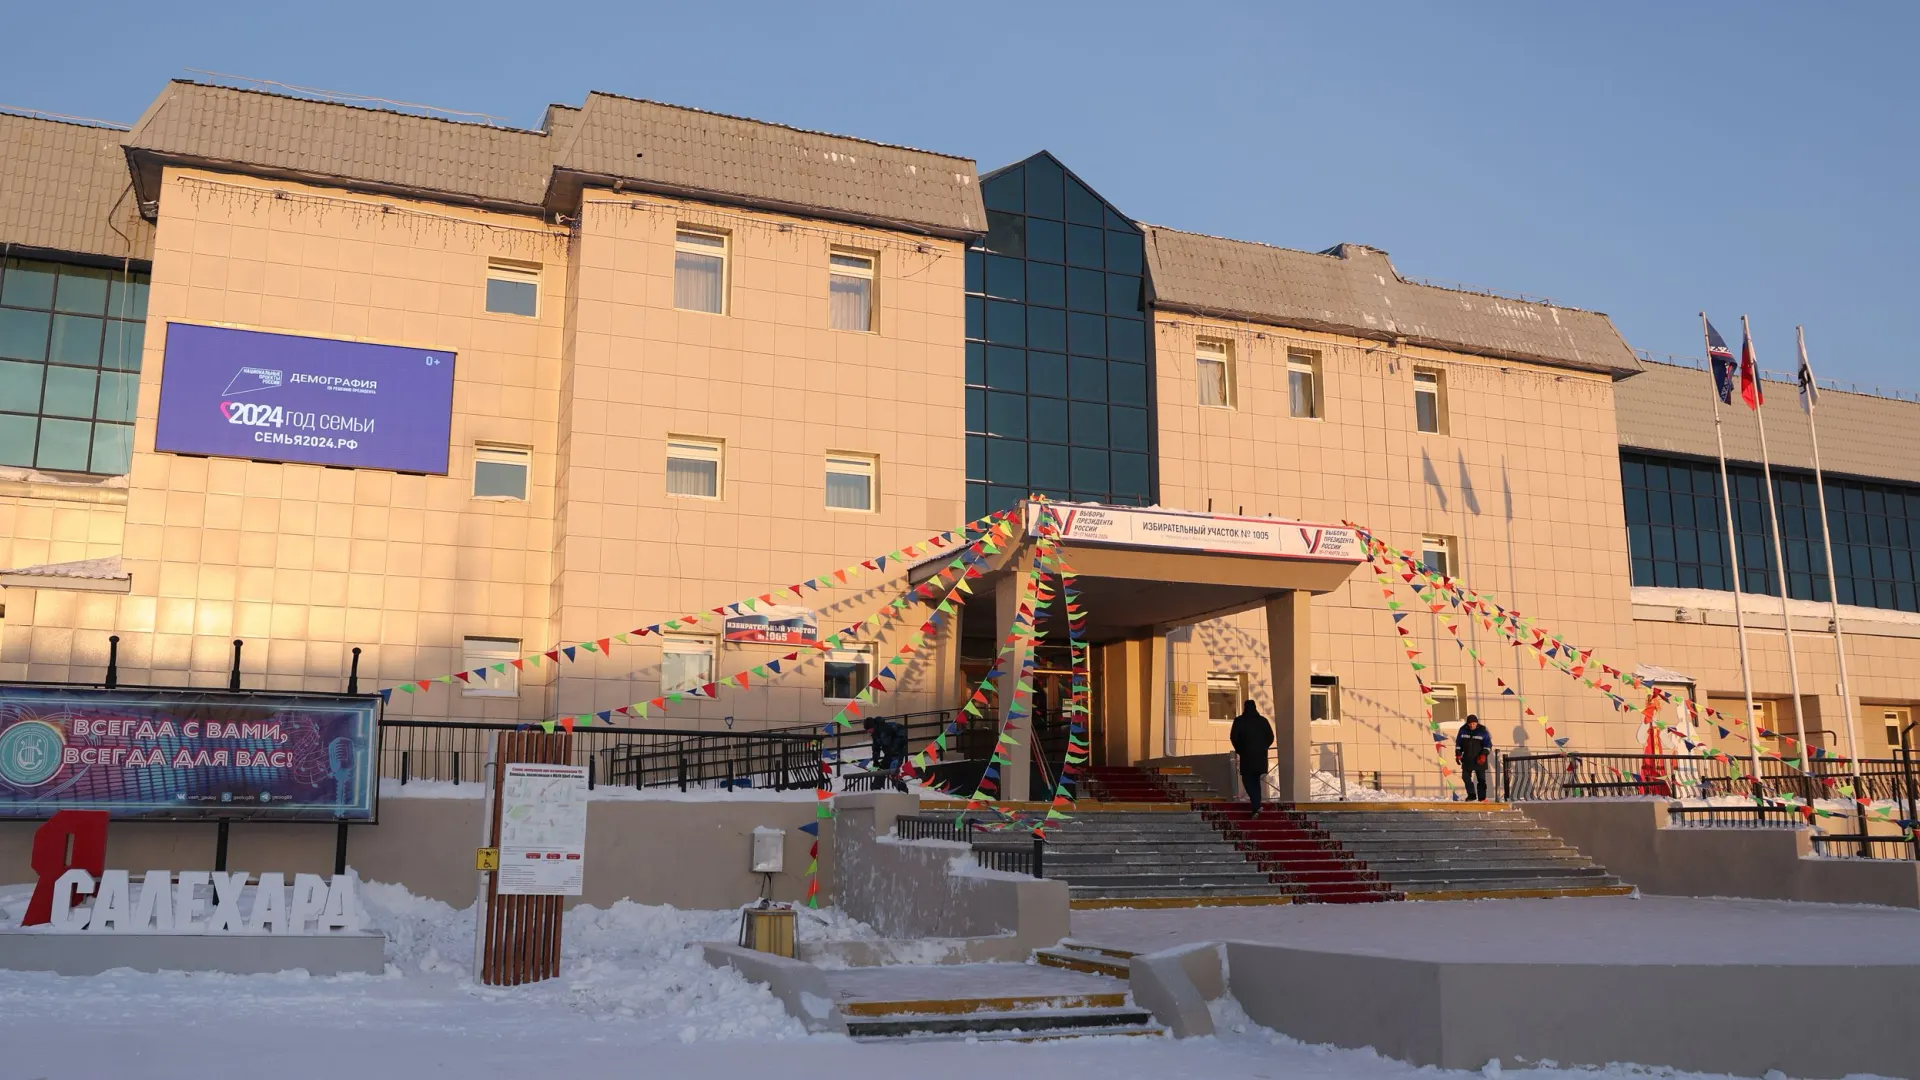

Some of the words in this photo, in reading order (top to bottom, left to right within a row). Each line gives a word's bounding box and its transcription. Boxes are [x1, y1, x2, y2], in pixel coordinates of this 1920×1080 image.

[425, 356, 441, 366] 0+
[290, 373, 377, 389] ДЕМОГРАФИЯ
[229, 402, 284, 428] 2024
[254, 431, 359, 450] СЕМЬЯ2024.РФ
[1079, 510, 1106, 518] ВЫБОРЫ
[1076, 517, 1114, 526] ПРЕЗИДЕНТА
[1074, 525, 1098, 533] РОССИИ
[1142, 521, 1207, 536] ИЗБИРАТЕЛЬНЫЙ
[1207, 528, 1241, 538] УЧАСТОК
[1241, 530, 1252, 538] №
[1252, 530, 1270, 540] 1005
[1324, 529, 1348, 537] ВЫБОРЫ
[1323, 536, 1355, 544] ПРЕЗИДЕНТА
[726, 622, 786, 632] ИЗБИРАТЕЛЬНЫЙ
[787, 626, 816, 634] УЧАСТОК
[73, 719, 175, 740] ВСЕГДА
[183, 722, 199, 737] С
[206, 722, 288, 744] ВАМИ,
[63, 747, 166, 769] ВСЕГДА
[173, 750, 228, 769] ДЛЯ
[235, 752, 294, 768] ВАС!
[21, 810, 109, 927] Я
